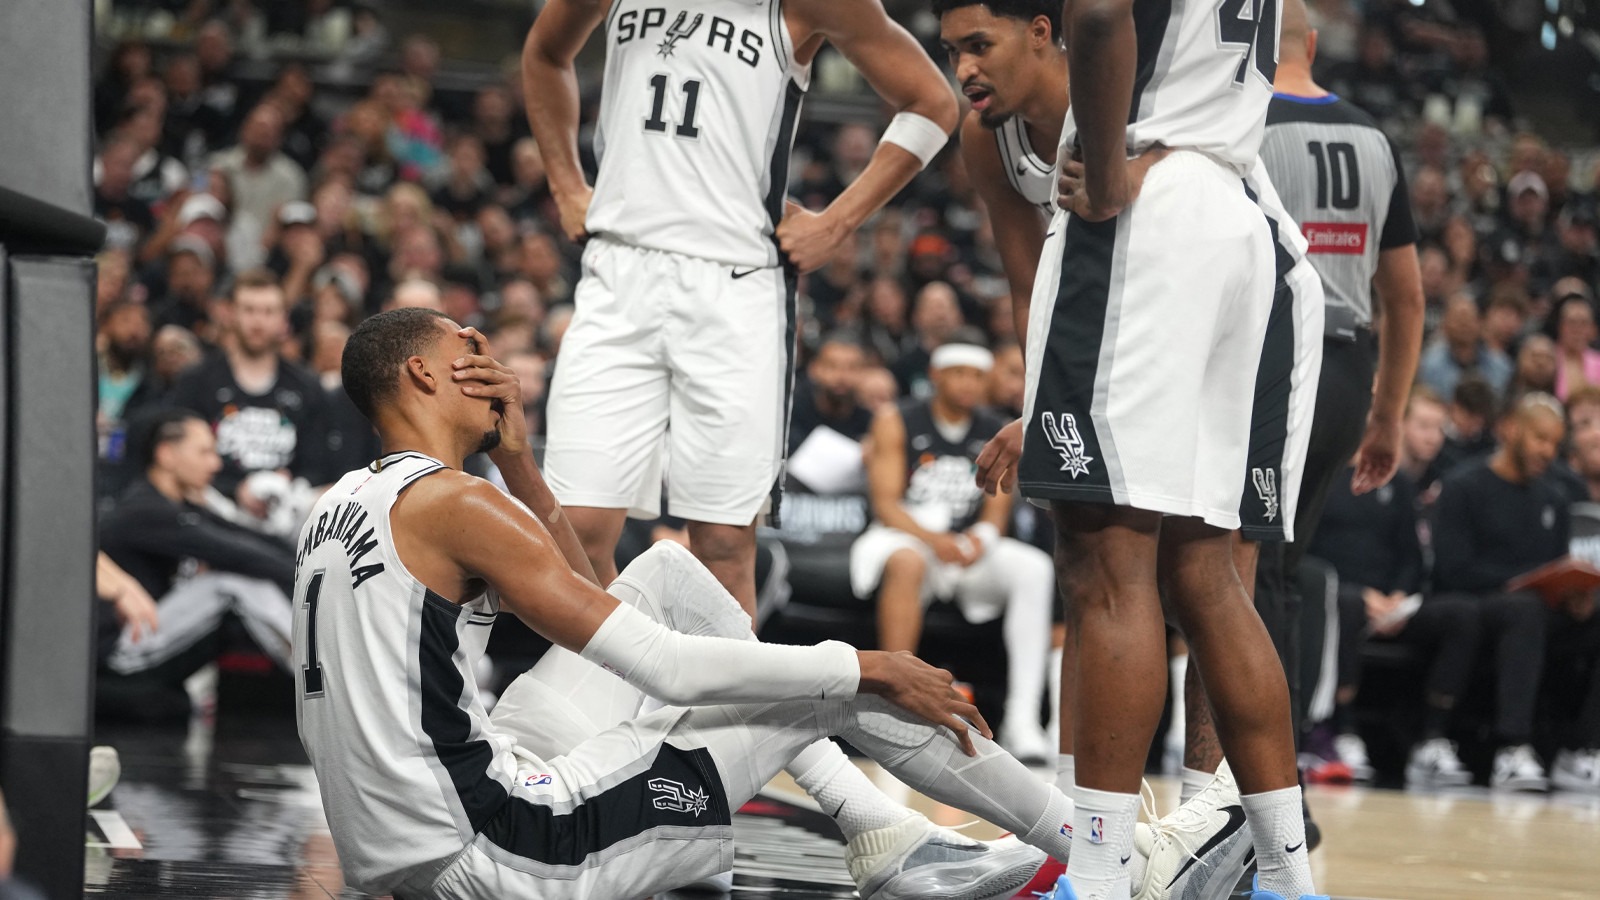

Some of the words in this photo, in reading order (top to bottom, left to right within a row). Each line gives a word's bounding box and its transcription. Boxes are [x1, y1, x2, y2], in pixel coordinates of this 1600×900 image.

[617, 8, 763, 68] SPURS
[643, 73, 702, 141] 11
[1307, 140, 1360, 210] 10
[1306, 227, 1361, 246] Emirates
[302, 567, 326, 700] 1
